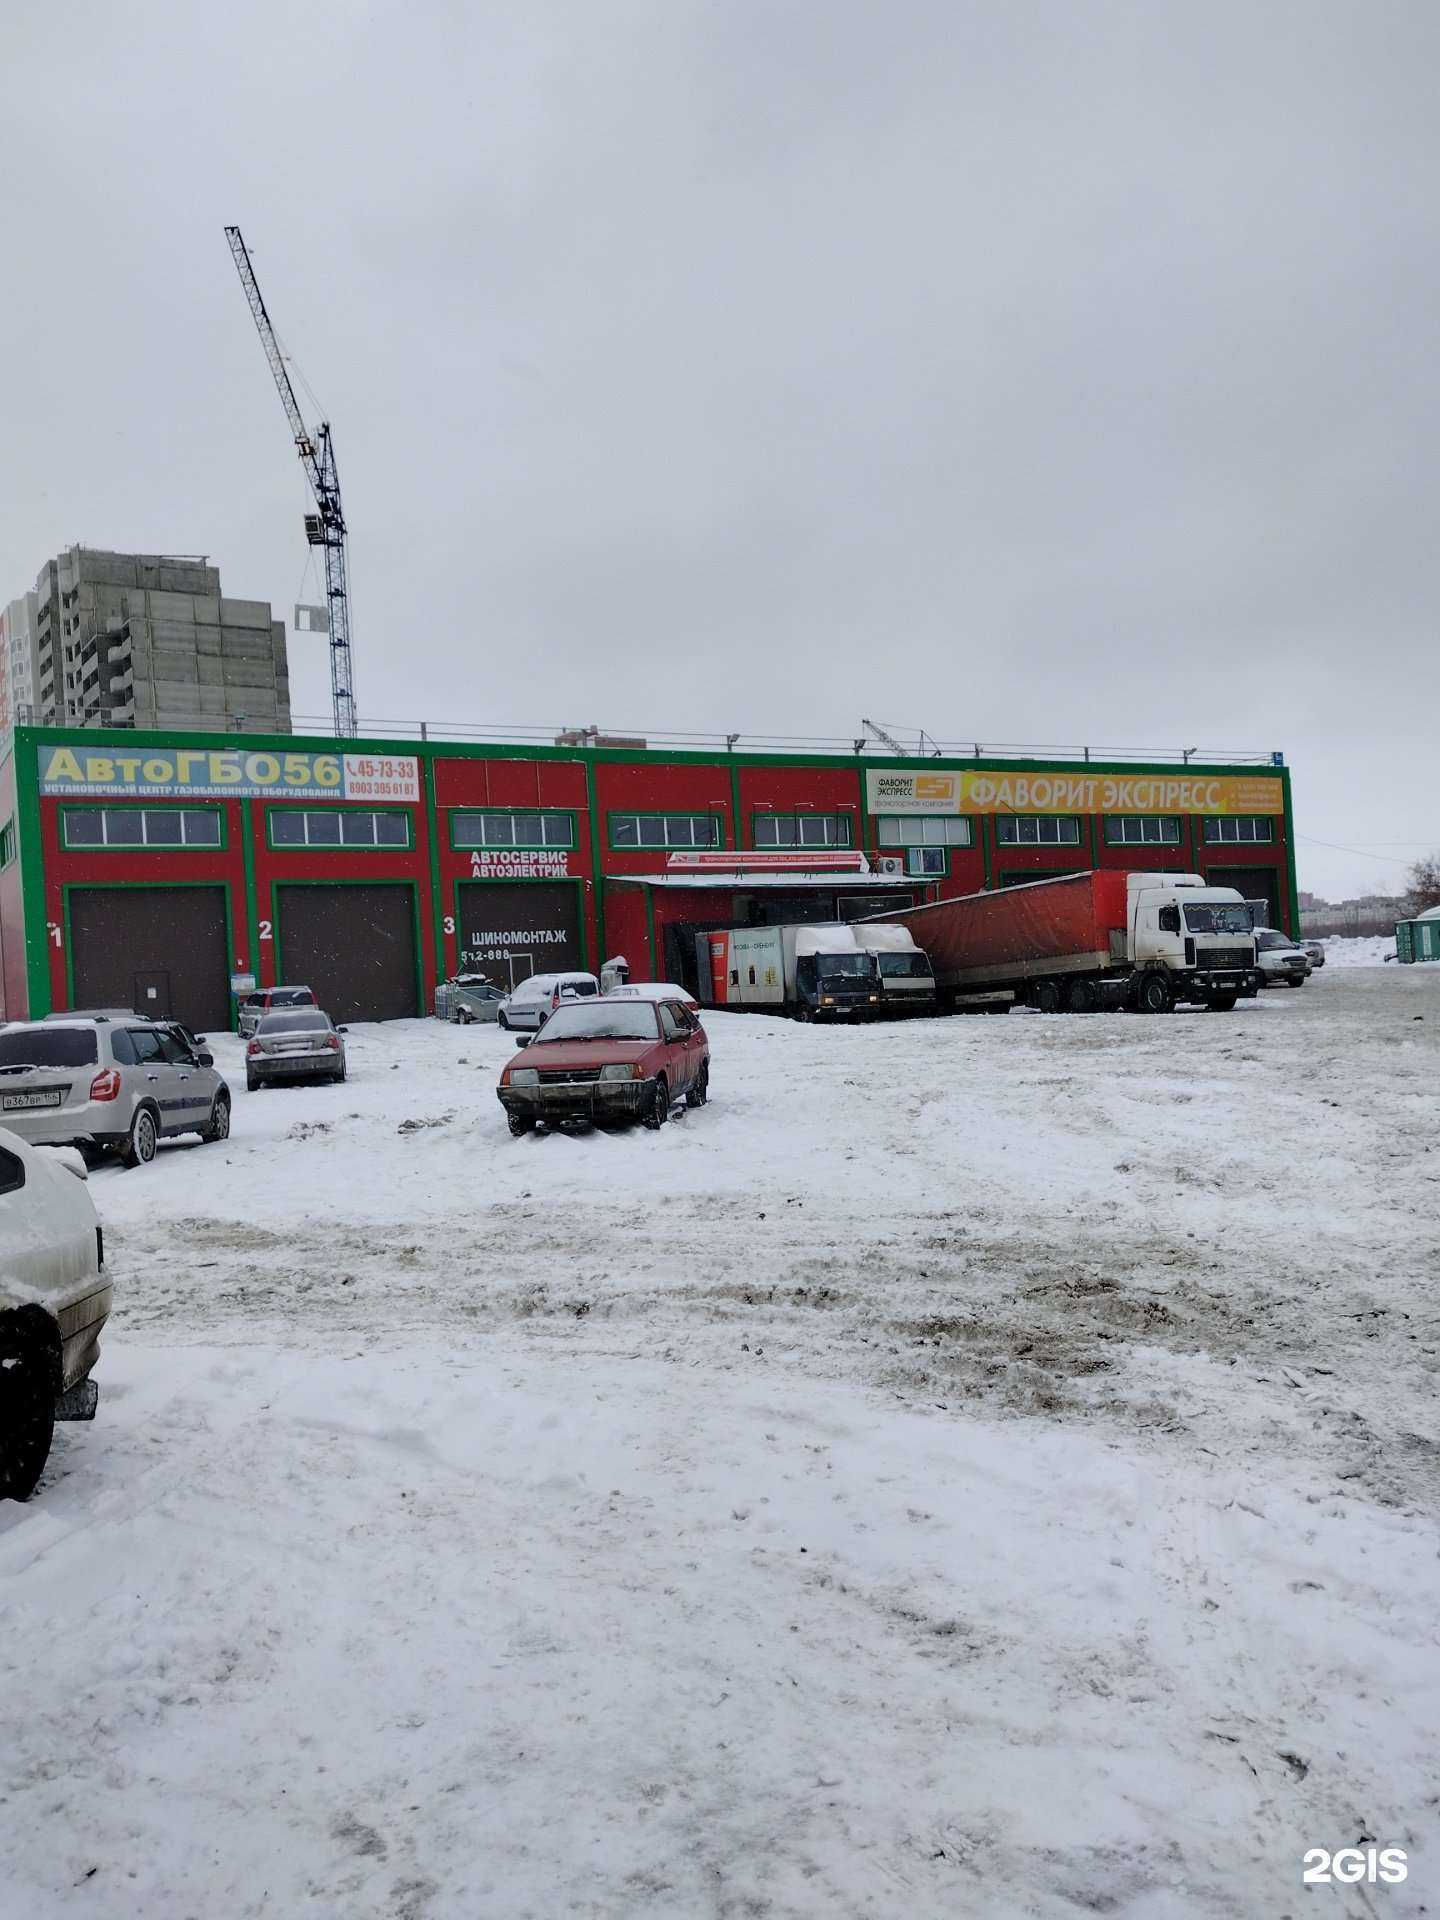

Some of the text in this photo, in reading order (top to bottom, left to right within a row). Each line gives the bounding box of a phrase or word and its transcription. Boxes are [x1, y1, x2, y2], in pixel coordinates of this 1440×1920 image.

[44, 748, 341, 786] АвтоГБО56
[358, 760, 414, 778] 45-73-33
[138, 785, 173, 795] ЦЕНТР
[878, 778, 913, 787] ФАВОРИТ
[877, 787, 913, 796] ЭКСПРЕСС
[969, 777, 1221, 809] ФАВОРИТ ЭКСПРЕСС
[470, 851, 568, 864] АВТОСЕРВИС
[472, 864, 568, 877] АВТОЭЛЕКТРИК
[258, 920, 273, 940] 2
[443, 916, 456, 935] 3
[50, 926, 62, 947] 1
[471, 929, 567, 946] ШИНОМОНТАЖ
[460, 949, 510, 962] 512-888
